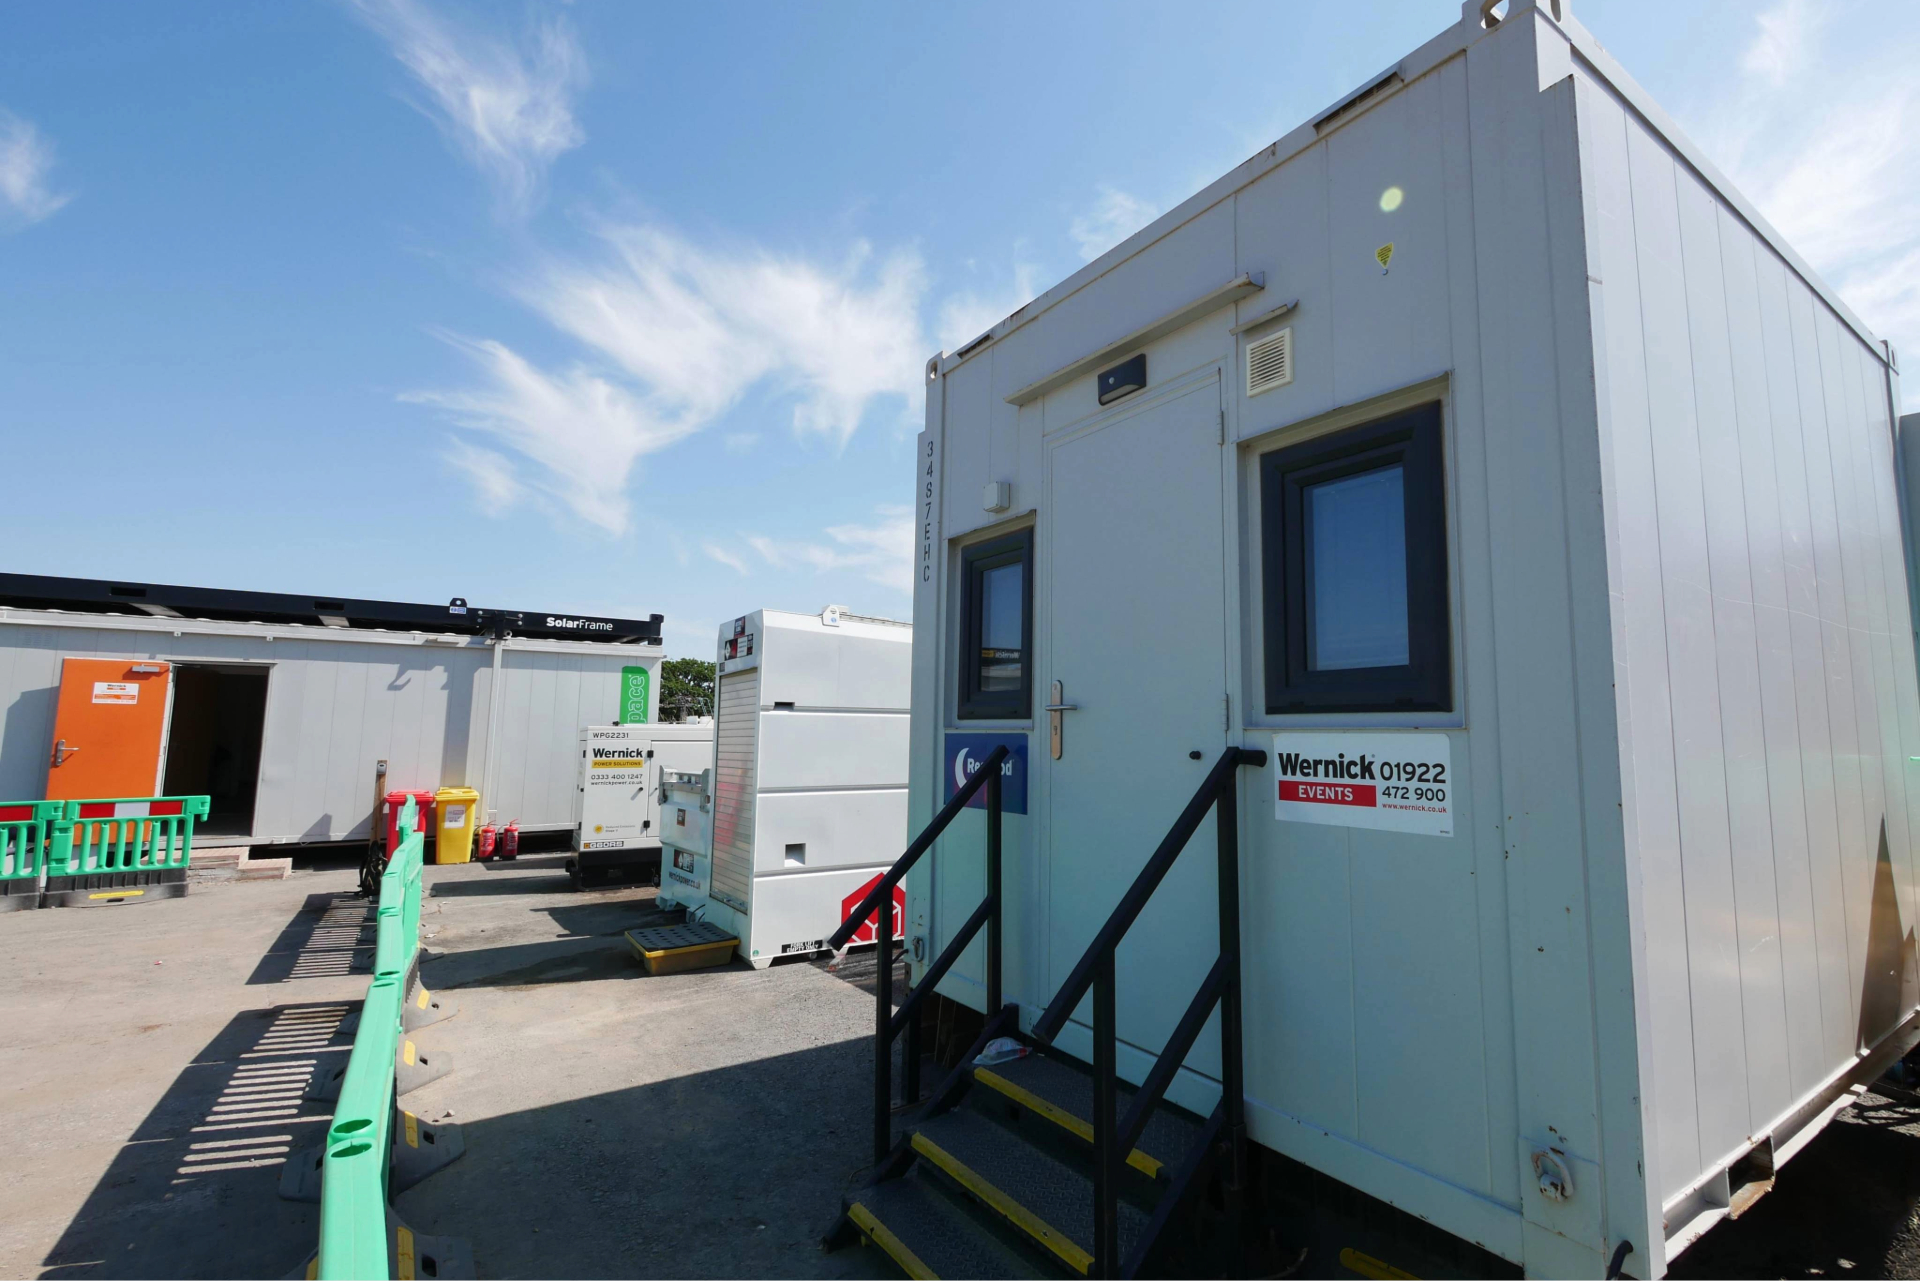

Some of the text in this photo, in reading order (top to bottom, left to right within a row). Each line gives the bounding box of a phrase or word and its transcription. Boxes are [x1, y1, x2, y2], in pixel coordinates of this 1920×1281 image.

[546, 617, 613, 630] SolarFrame
[592, 747, 643, 758] Wernick
[1277, 753, 1376, 780] Wernick
[1379, 761, 1447, 784] 01922
[1298, 785, 1354, 801] EVENTS
[1382, 786, 1446, 802] 472 900
[1382, 802, 1447, 813] www.wernick.co.uk
